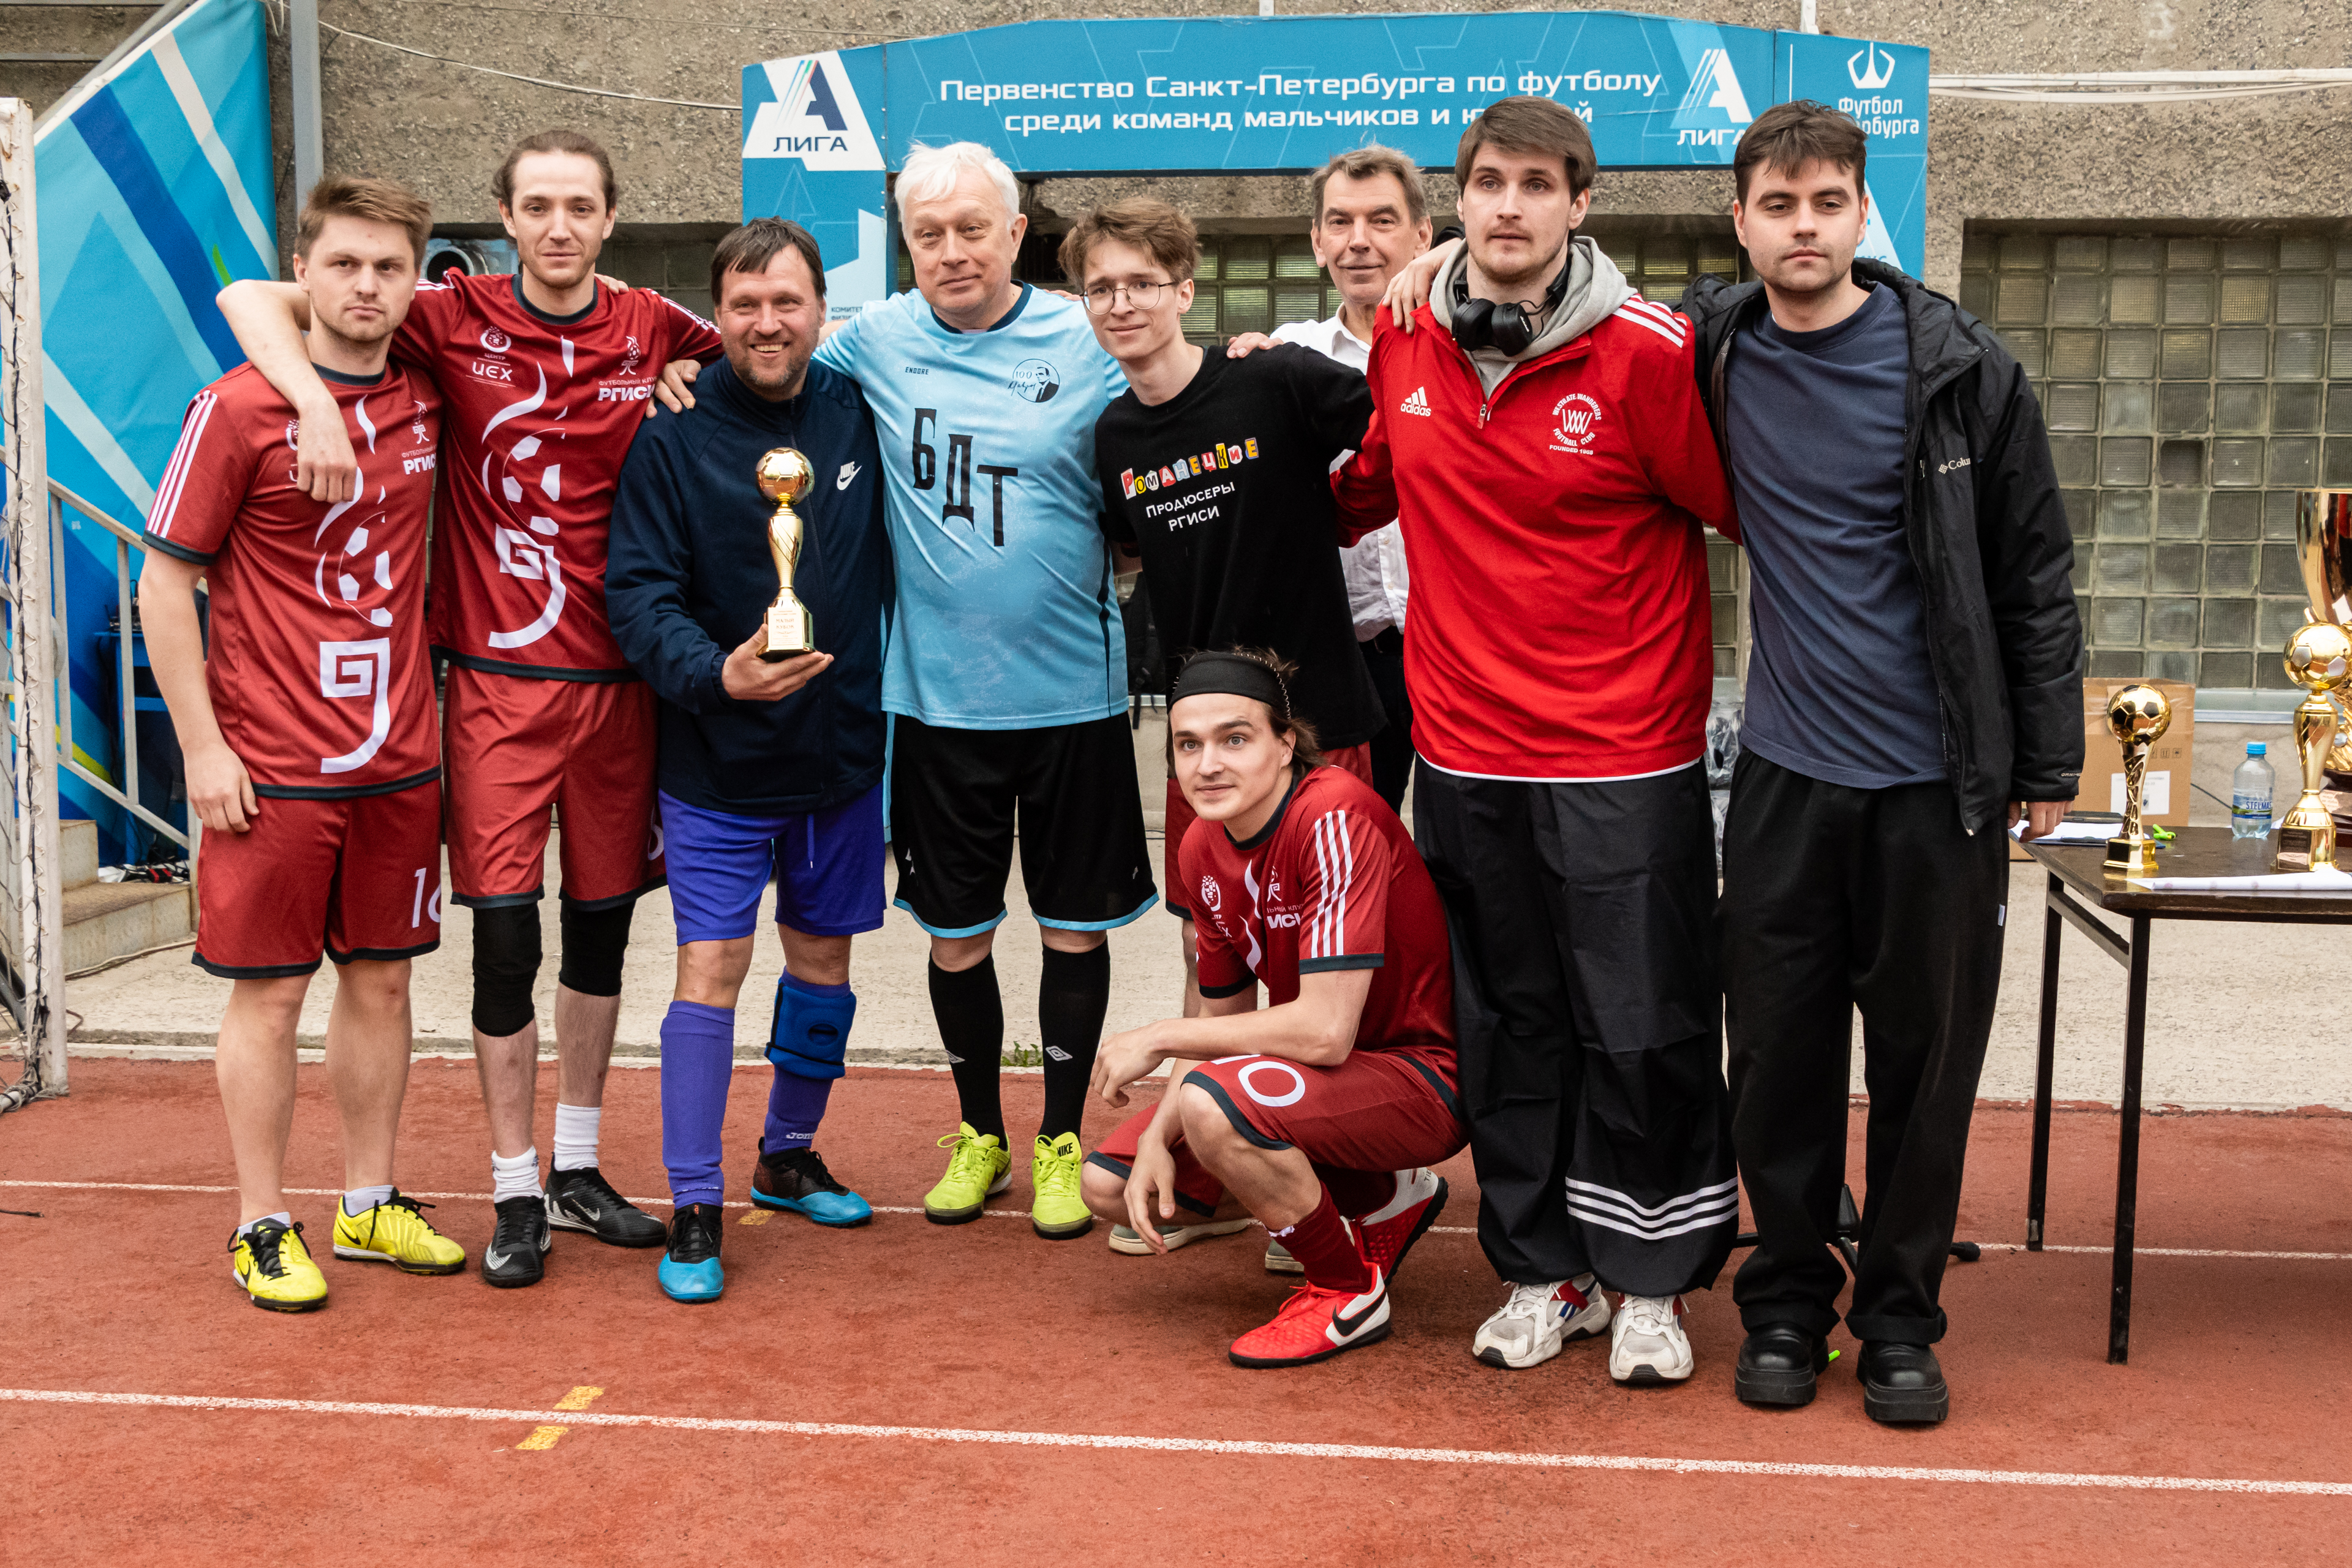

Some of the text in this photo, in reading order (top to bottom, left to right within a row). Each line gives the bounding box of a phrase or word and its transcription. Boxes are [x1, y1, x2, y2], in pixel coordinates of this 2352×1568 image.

[941, 70, 1661, 107] Первенство Санкт-Петербурга по футболу
[1838, 96, 1902, 119] Футбол
[1005, 115, 1101, 137] среди
[1112, 111, 1234, 131] команд
[1245, 108, 1419, 127] мальчиков
[1431, 108, 1450, 124] и
[773, 137, 848, 152] ЛИГА
[472, 361, 513, 382] ЦЕХ
[1400, 402, 1431, 417] adidas
[1553, 428, 1596, 447] FOOTBALL CLUB
[1549, 445, 1578, 453] FOUNDED
[402, 453, 437, 475] РГИС
[912, 408, 1019, 546] БДТ
[1167, 505, 1221, 532] РГИСИ
